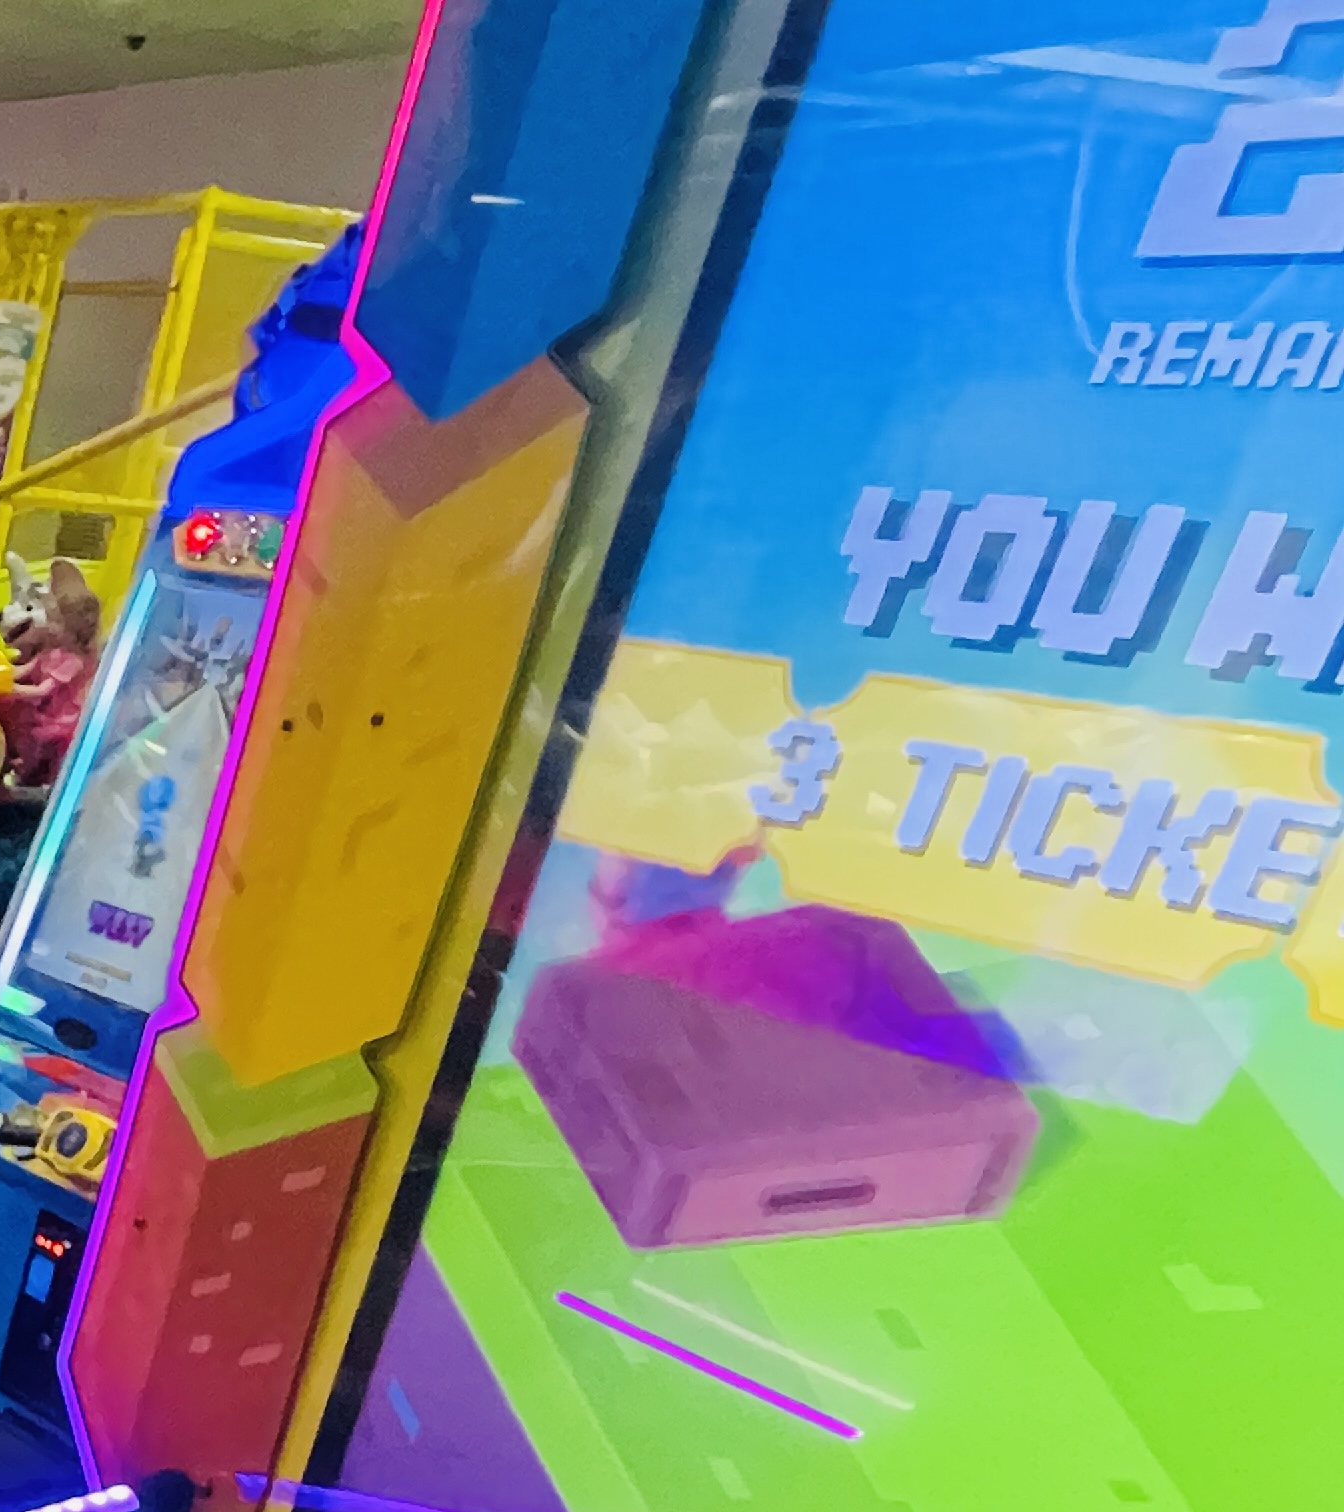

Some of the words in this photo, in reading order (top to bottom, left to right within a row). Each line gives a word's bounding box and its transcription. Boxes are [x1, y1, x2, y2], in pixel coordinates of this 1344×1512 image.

[840, 486, 1196, 660] YOU
[747, 718, 842, 829] 3
[894, 738, 1344, 934] TICKE
